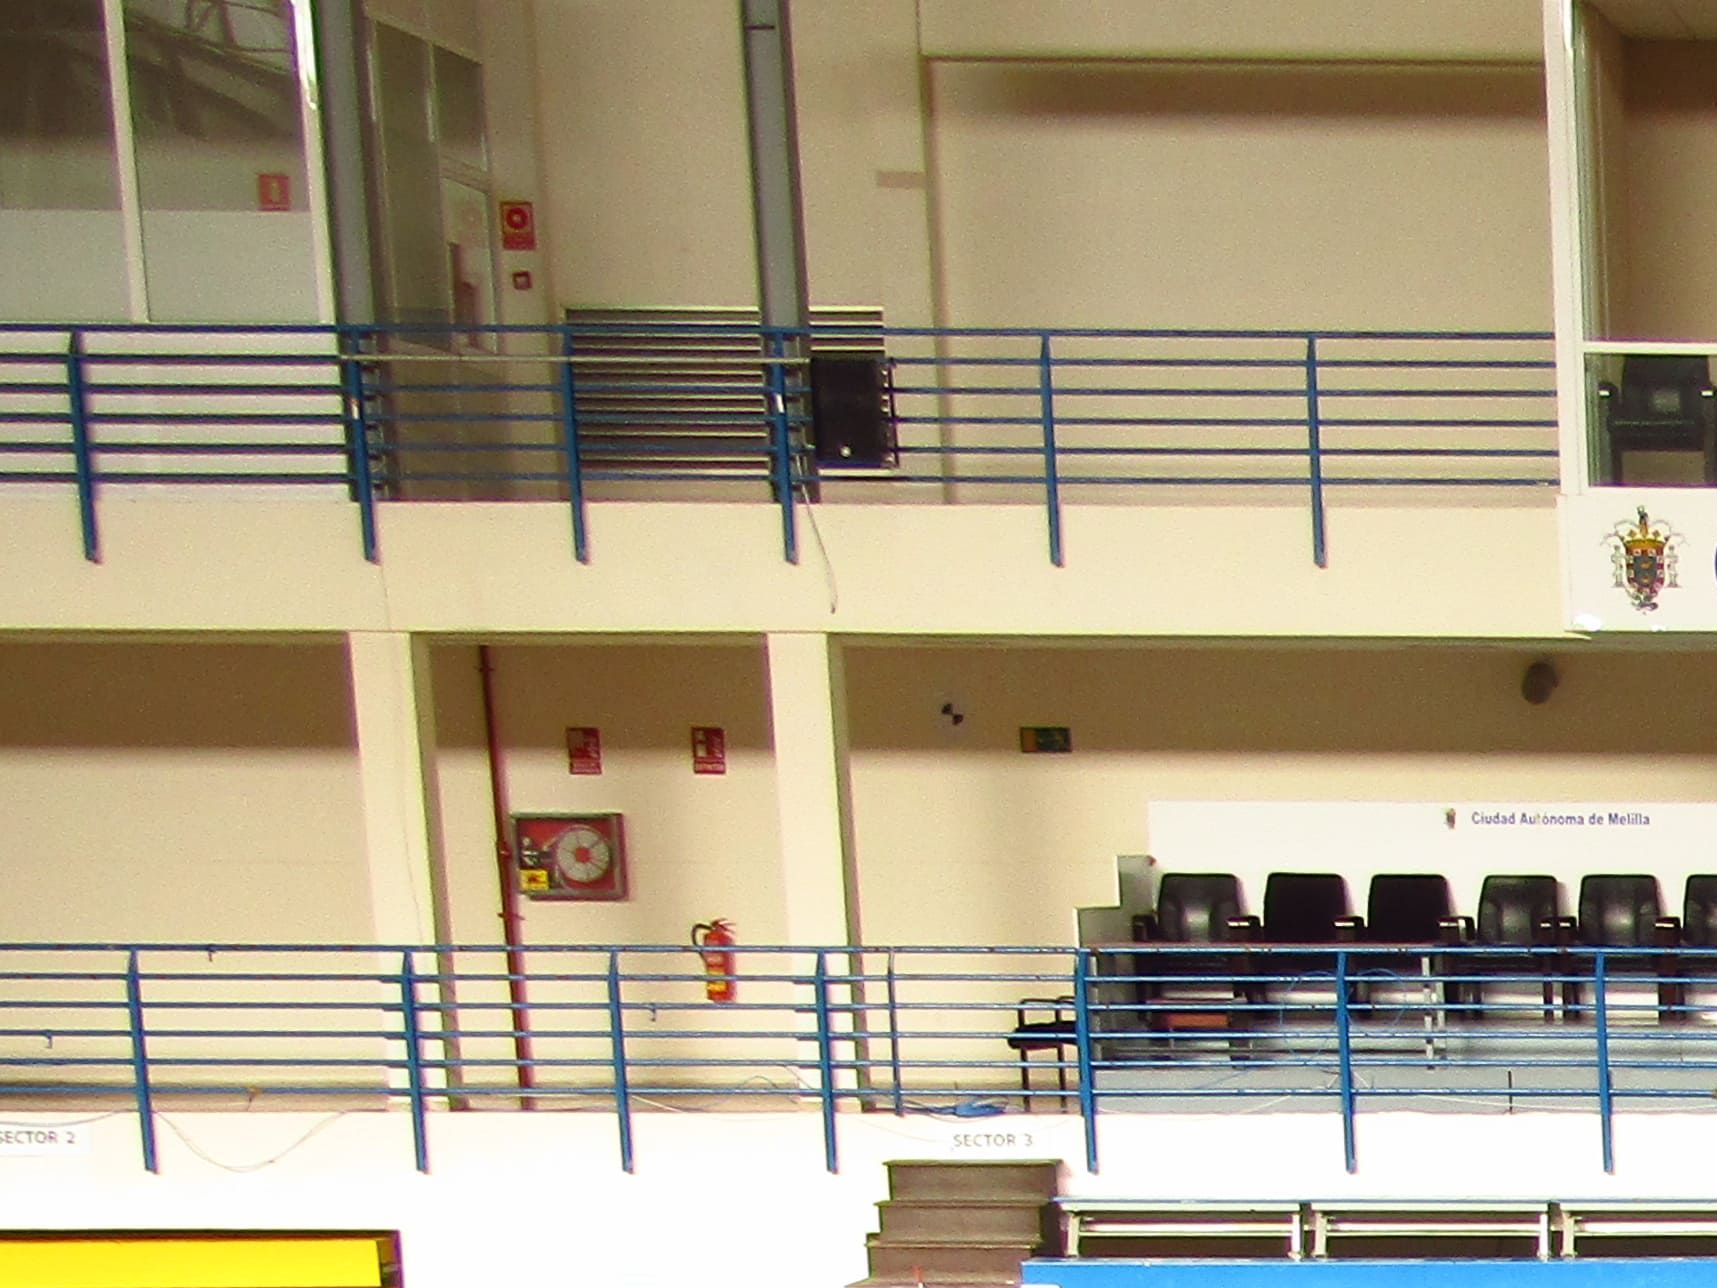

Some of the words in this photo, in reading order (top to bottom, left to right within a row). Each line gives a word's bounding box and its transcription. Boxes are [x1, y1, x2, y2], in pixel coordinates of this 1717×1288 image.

[1471, 811, 1516, 825] Ciudad
[1520, 811, 1584, 825] Autónoma
[1588, 812, 1604, 825] de
[1608, 812, 1650, 826] Melilla
[0, 1131, 58, 1144] ECTOR
[65, 1131, 75, 1144] 2
[953, 1133, 1016, 1147] SECTOR
[1023, 1133, 1033, 1146] 3
